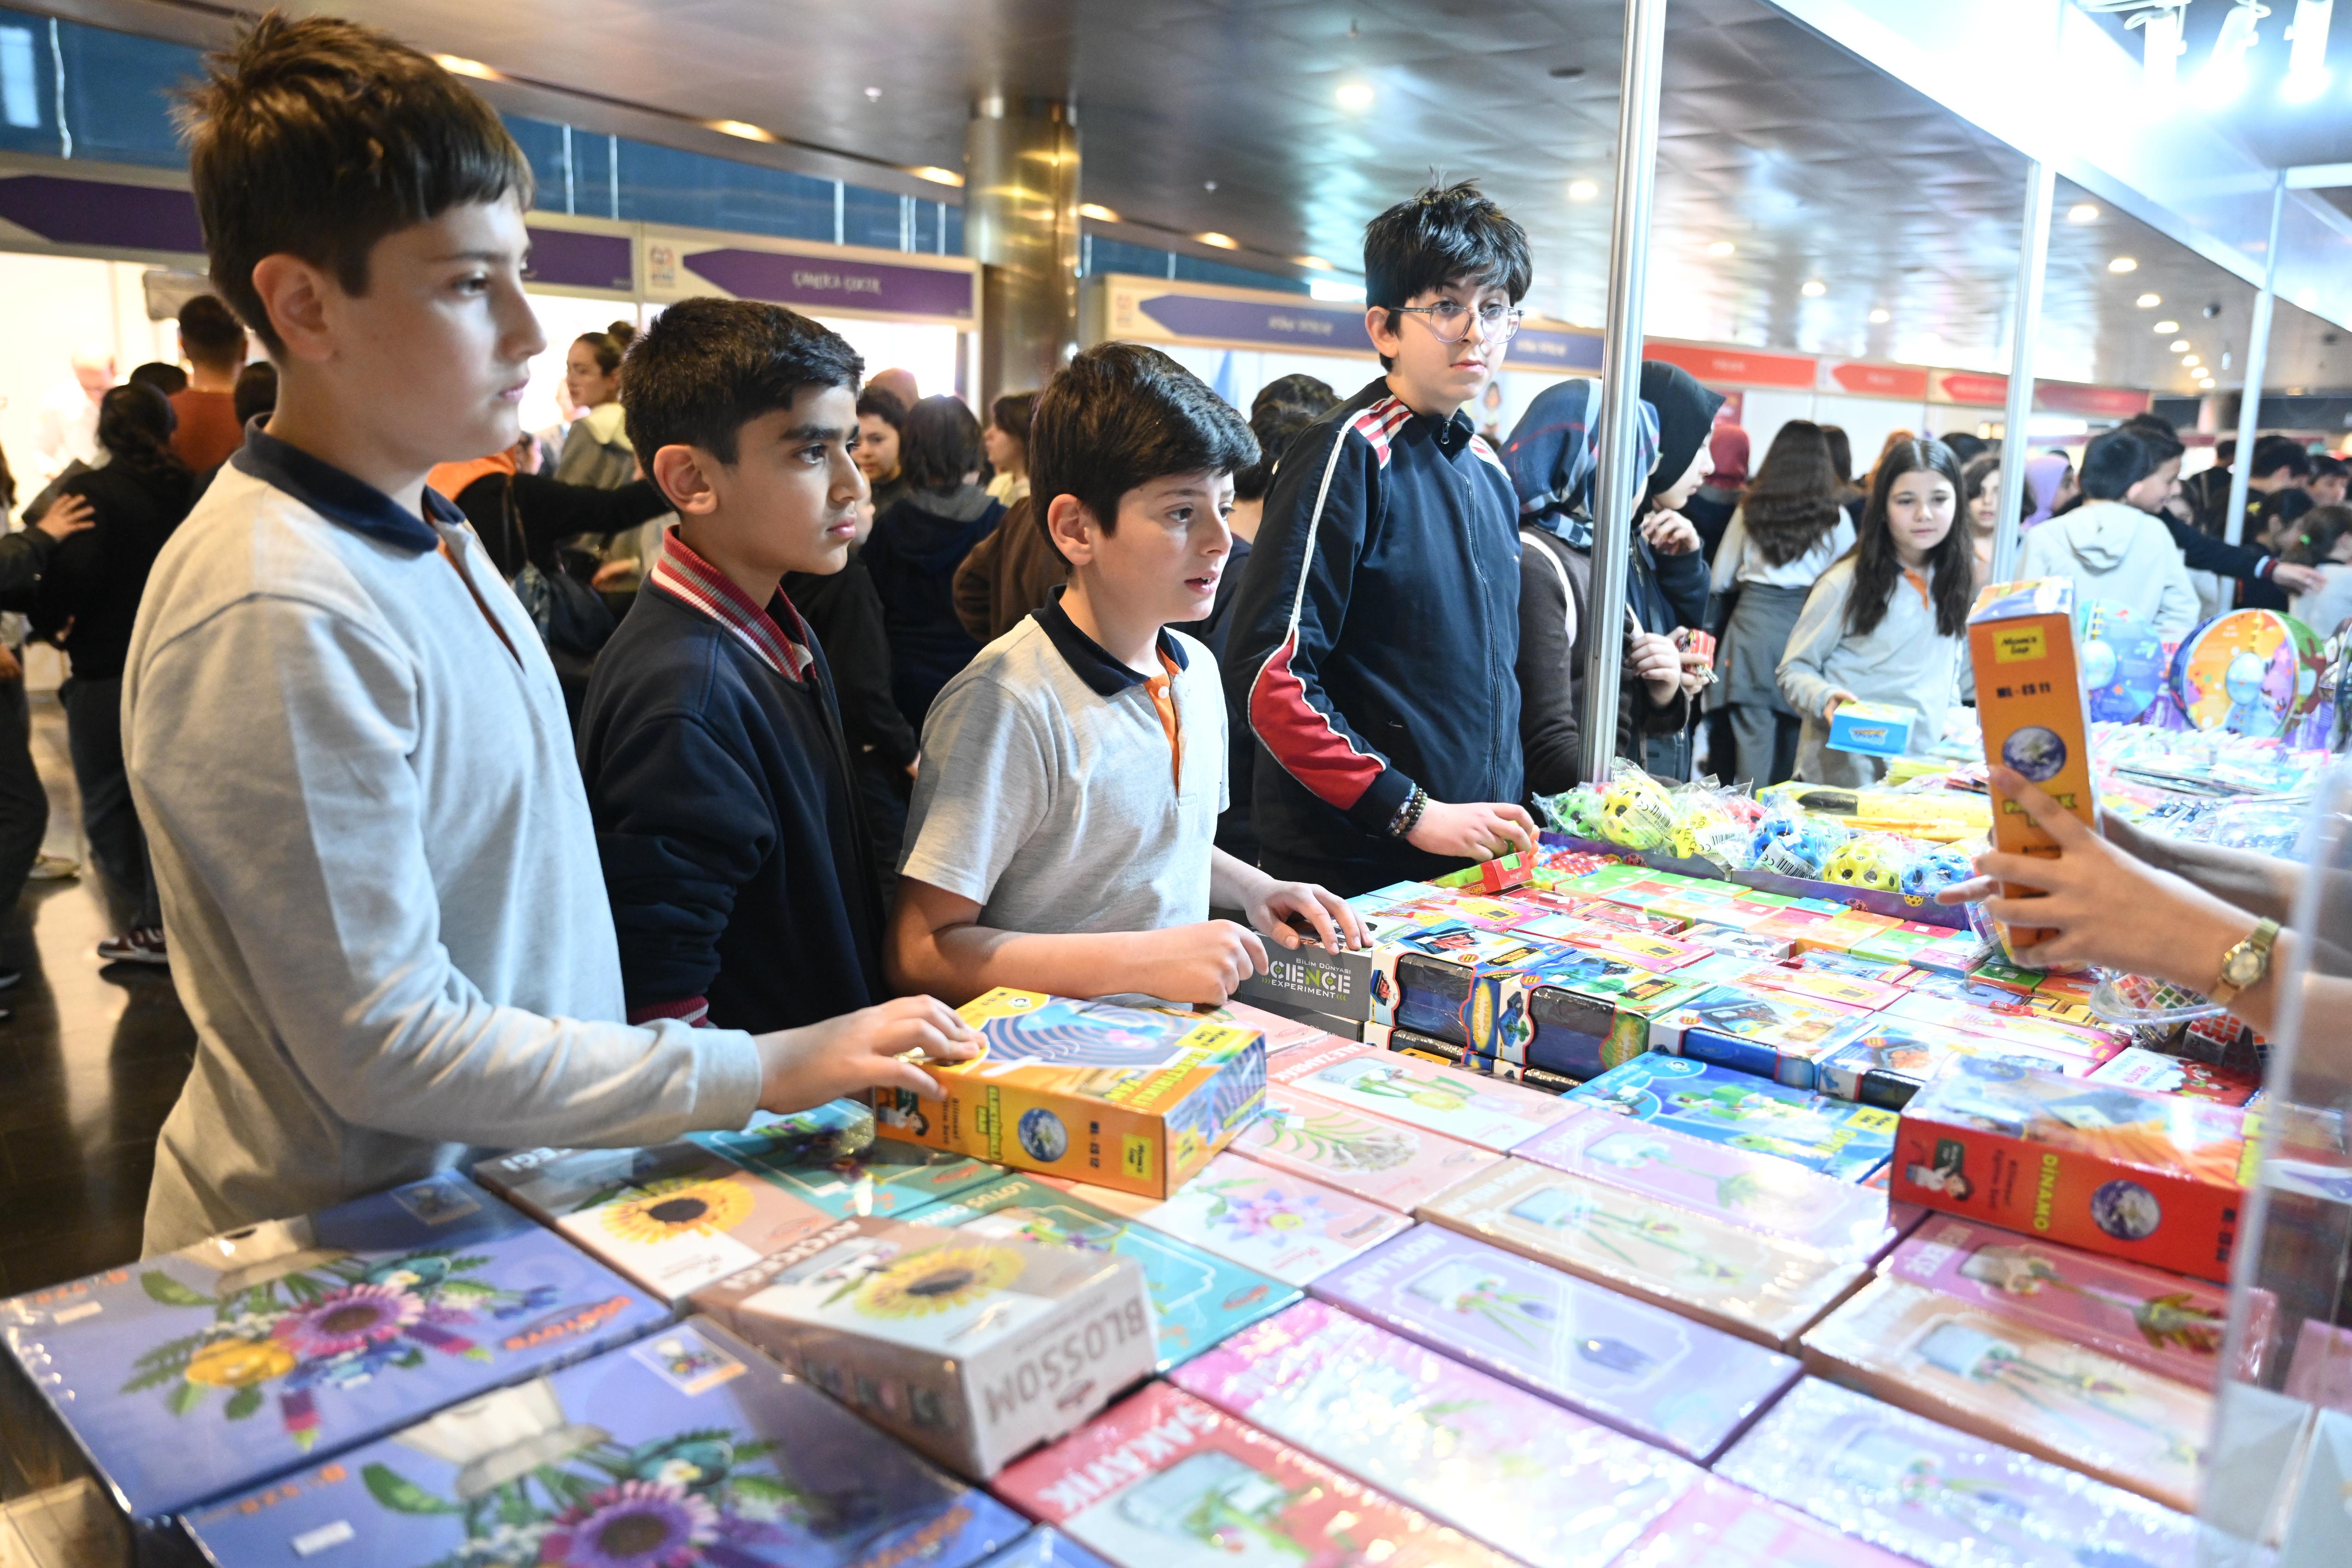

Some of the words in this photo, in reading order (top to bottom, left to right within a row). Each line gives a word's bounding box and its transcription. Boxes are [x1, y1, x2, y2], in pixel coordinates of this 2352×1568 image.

[1270, 960, 1351, 994] CIENCE
[1296, 958, 1317, 967] BİLİM
[1319, 962, 1351, 975] DÜNYASI
[1271, 979, 1336, 999] EXPERIMENT
[1483, 1000, 1492, 1033] TURBO
[1328, 1042, 1370, 1057] LALE
[1269, 1053, 1337, 1081] ZAMBAK
[967, 1180, 1031, 1210] LOTUS
[2033, 1153, 2059, 1232] DİNAMO
[985, 1296, 1145, 1423] BLOSSOM
